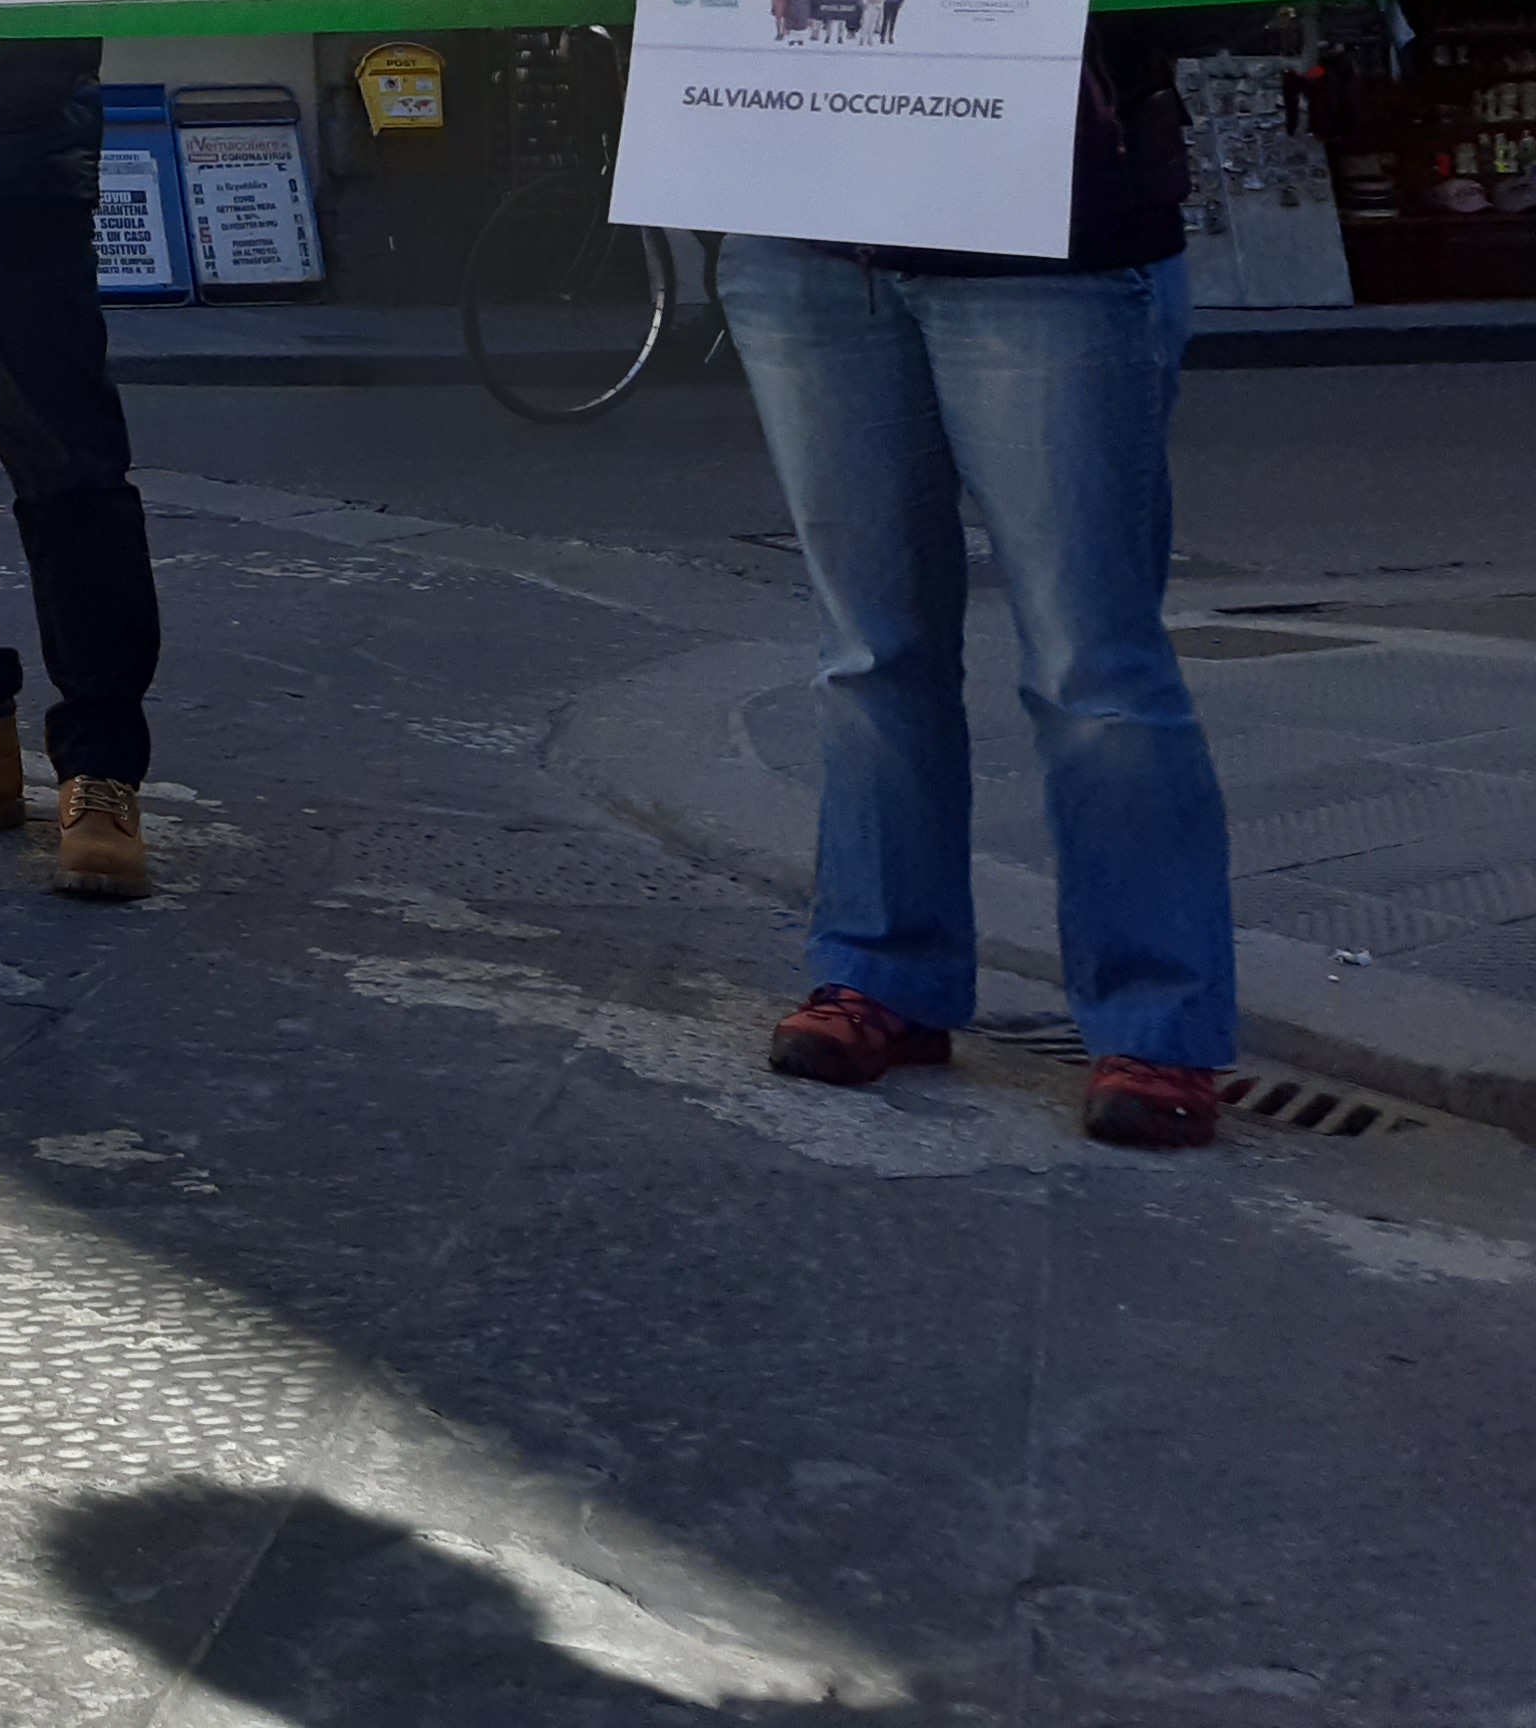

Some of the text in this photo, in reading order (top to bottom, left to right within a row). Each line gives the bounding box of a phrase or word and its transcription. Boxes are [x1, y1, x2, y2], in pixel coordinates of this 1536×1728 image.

[386, 59, 416, 67] POST
[681, 85, 1005, 120] SALVIAMO L'OCCUPAZIONE
[220, 151, 292, 161] CORONAVIRUS
[100, 217, 145, 229] SCUOLA
[107, 230, 120, 242] UN
[124, 230, 152, 242] CASO
